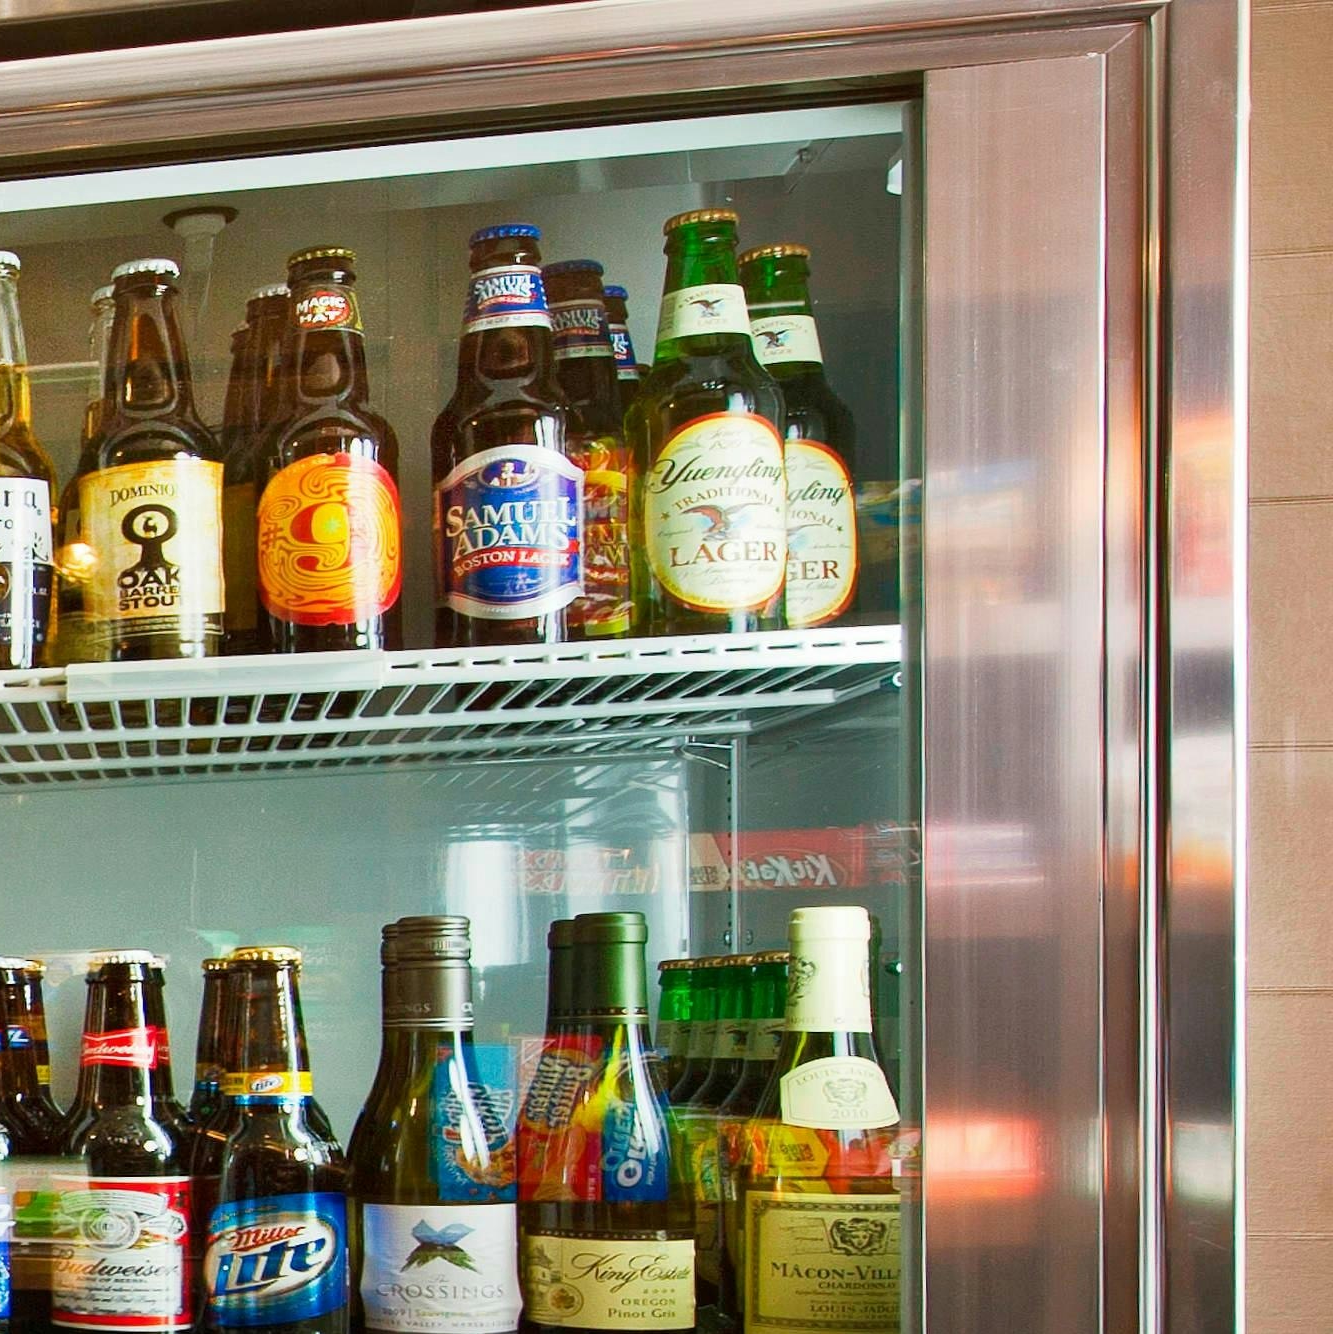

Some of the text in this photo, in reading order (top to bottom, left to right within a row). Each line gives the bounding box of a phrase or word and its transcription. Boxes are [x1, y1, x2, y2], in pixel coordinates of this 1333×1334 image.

[474, 273, 536, 294] SAMUEL
[296, 294, 347, 316] MAGIC
[299, 310, 341, 326] HAT
[647, 454, 783, 494] Yuengling
[671, 485, 775, 512] TRADITIONAL
[446, 497, 577, 538] SAMUEL
[452, 523, 570, 562] ADAMS
[669, 540, 778, 569] LAGER
[453, 549, 516, 577] BOSTON
[119, 585, 181, 599] BARRE
[232, 1225, 307, 1251] Miller
[214, 1236, 326, 1298] Lite
[565, 1252, 639, 1294] King
[375, 1282, 505, 1304] CROSSINGS
[621, 1298, 677, 1306] OREGON
[608, 1307, 646, 1318] Pinot
[810, 1304, 902, 1314] LOUIS JADO
